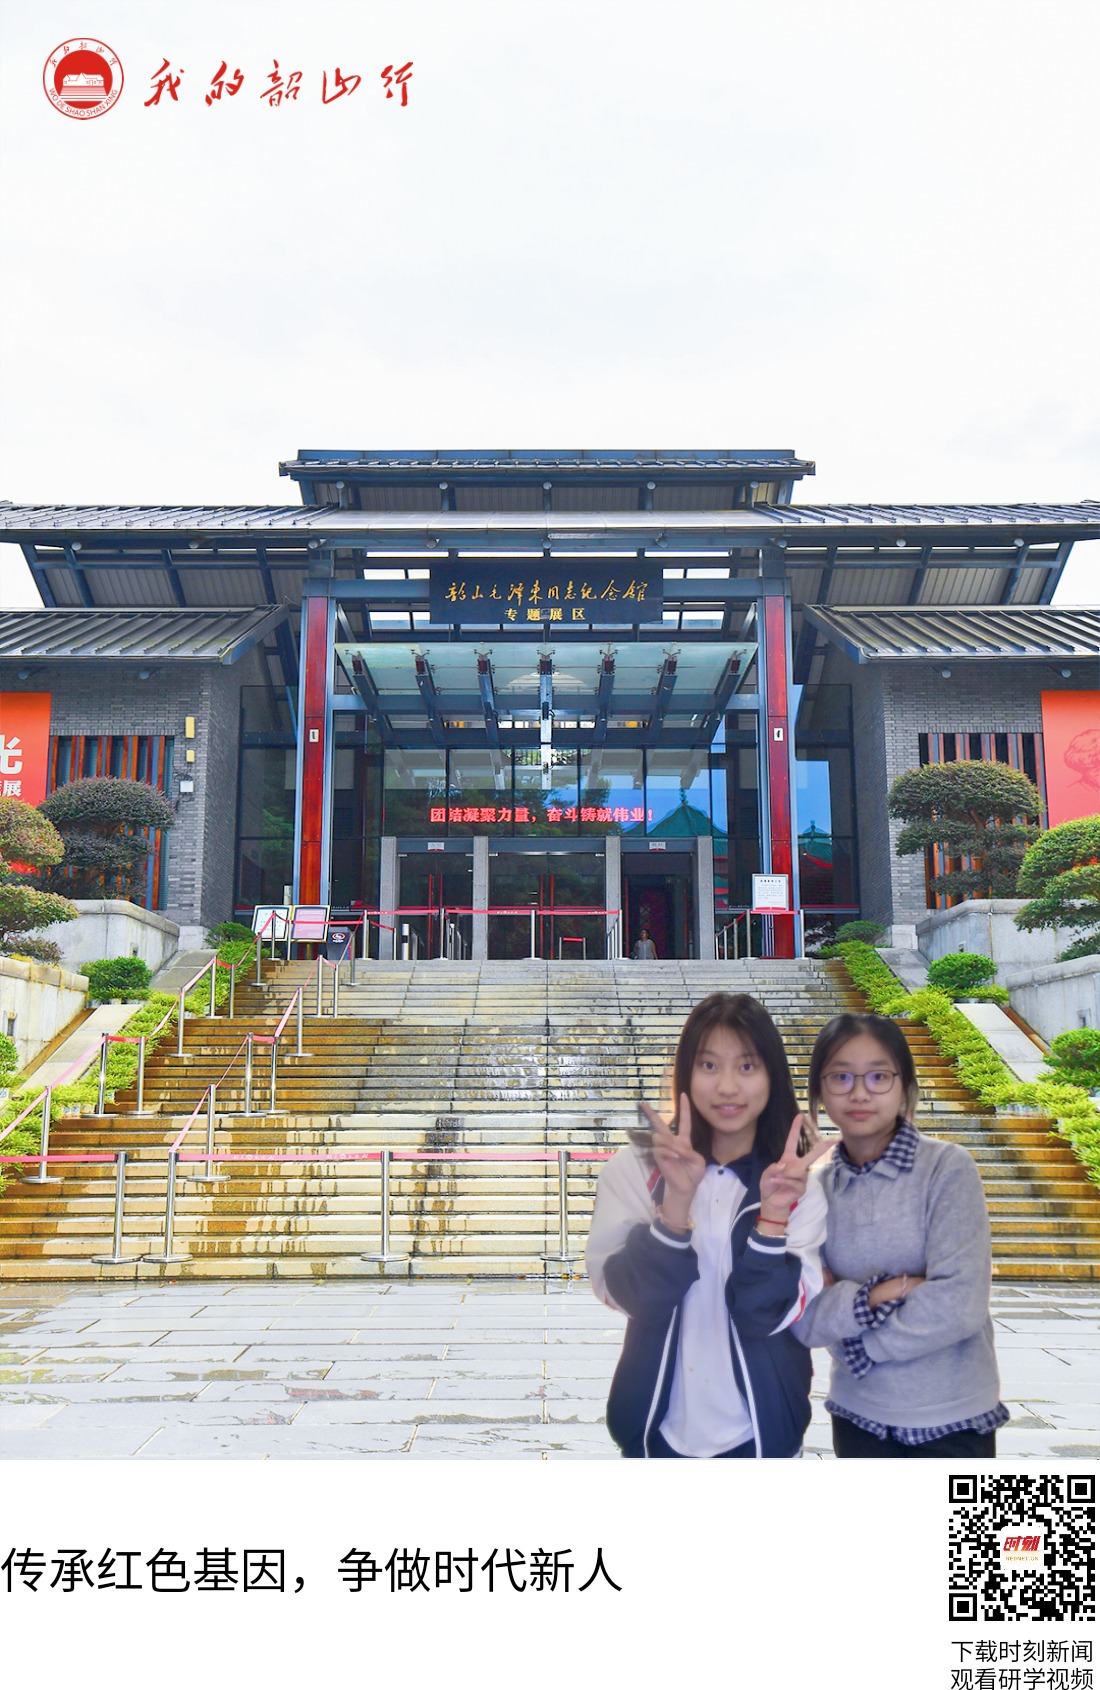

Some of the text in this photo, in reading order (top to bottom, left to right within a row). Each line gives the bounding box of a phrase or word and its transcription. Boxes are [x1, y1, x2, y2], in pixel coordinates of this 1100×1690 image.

[504, 607, 586, 621] 专题展区
[0, 779, 22, 797] 展
